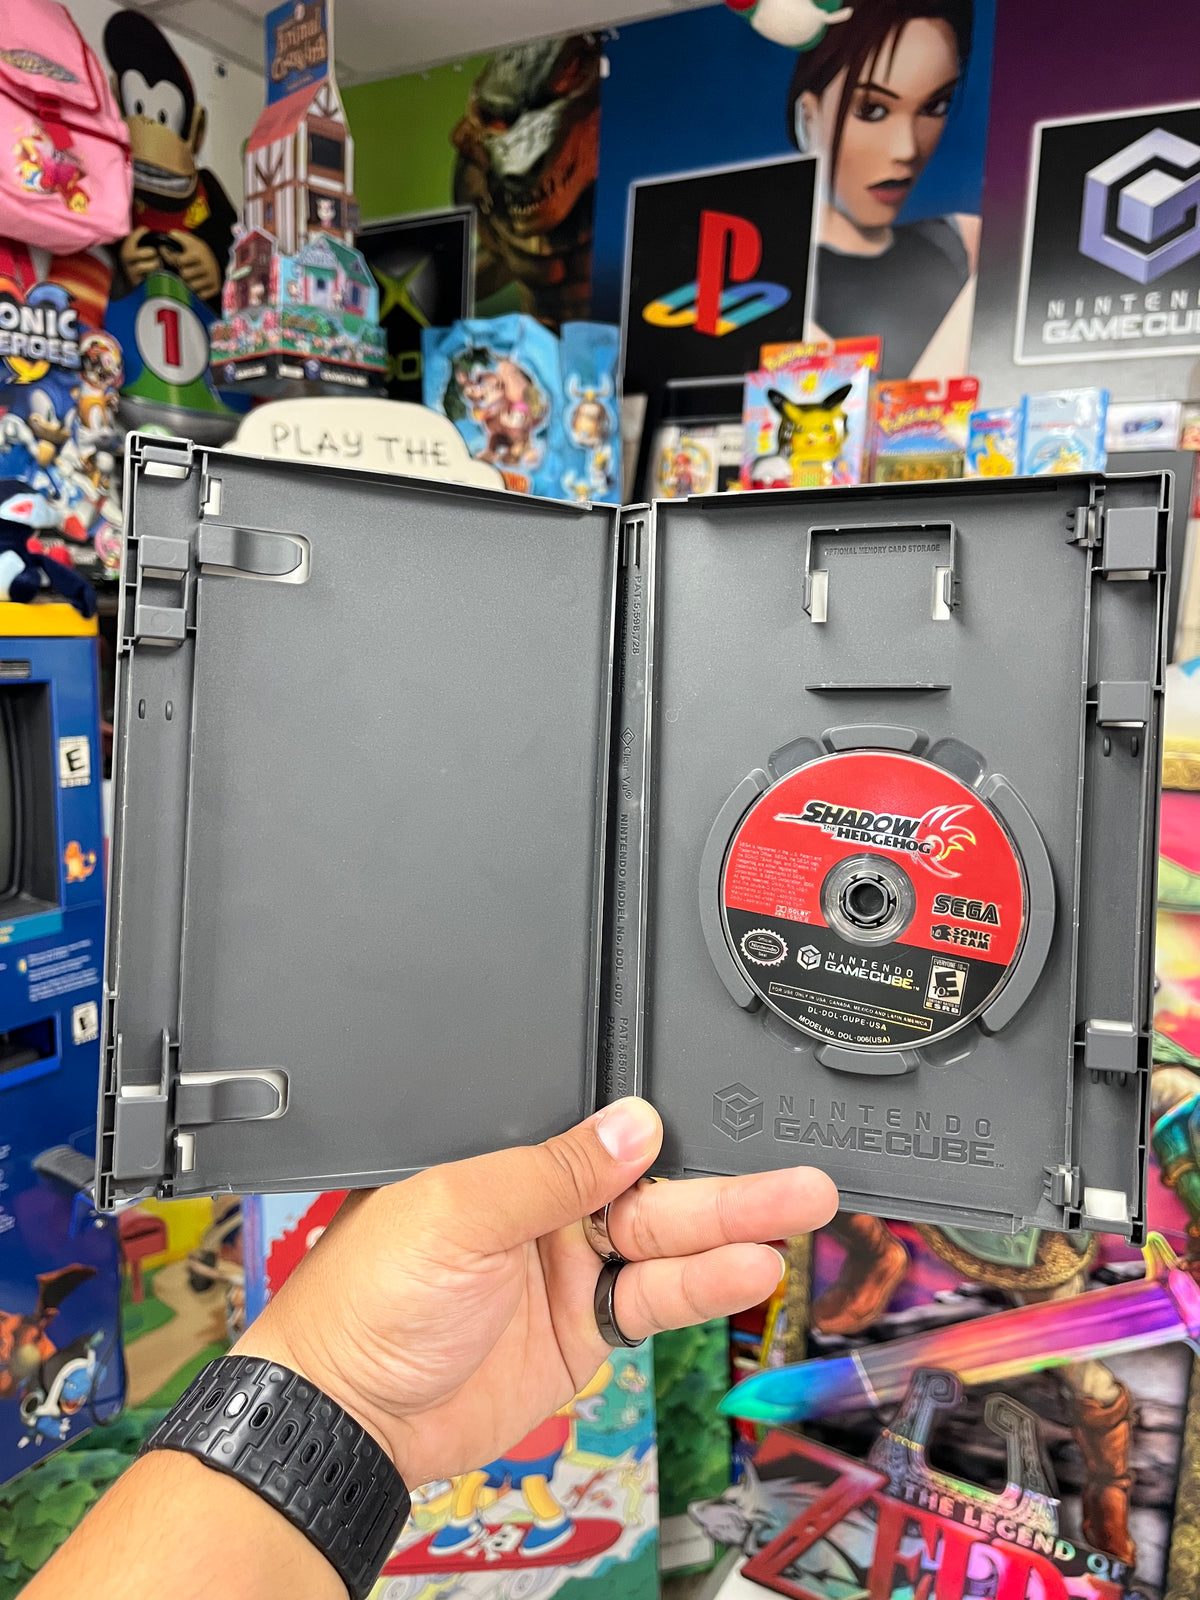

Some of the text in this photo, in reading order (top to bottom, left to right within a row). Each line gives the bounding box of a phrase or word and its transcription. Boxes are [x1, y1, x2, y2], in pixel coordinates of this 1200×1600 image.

[1047, 289, 1200, 319] NINTEN
[157, 309, 180, 367] 1
[1042, 310, 1200, 344] GAMECU
[271, 422, 448, 466] PLAY THE
[858, 546, 887, 554] MEMORY
[888, 545, 906, 553] CARD
[908, 544, 941, 553] STORAGE
[66, 748, 86, 772] E
[802, 802, 920, 838] SHADOW
[619, 814, 628, 878] NINTENDO
[836, 827, 932, 854] HEDGEHOG
[616, 880, 626, 923] MODEL
[933, 894, 999, 925] SEGA
[616, 926, 625, 946] No.
[751, 942, 778, 952] Nintendo
[952, 935, 989, 950] TEAM
[953, 927, 991, 942] SONIC
[824, 960, 914, 990] GAMECUBE
[828, 952, 914, 978] NINTENDO
[933, 959, 956, 968] EVERYONE
[935, 971, 960, 997] E
[925, 1001, 959, 1014] ESRB
[798, 1015, 823, 1032] MODEL
[778, 1095, 992, 1138] NINTENDO
[773, 1117, 996, 1168] GAMECUBE
[904, 1484, 954, 1517] THE
[963, 1505, 1076, 1562] LEGEND
